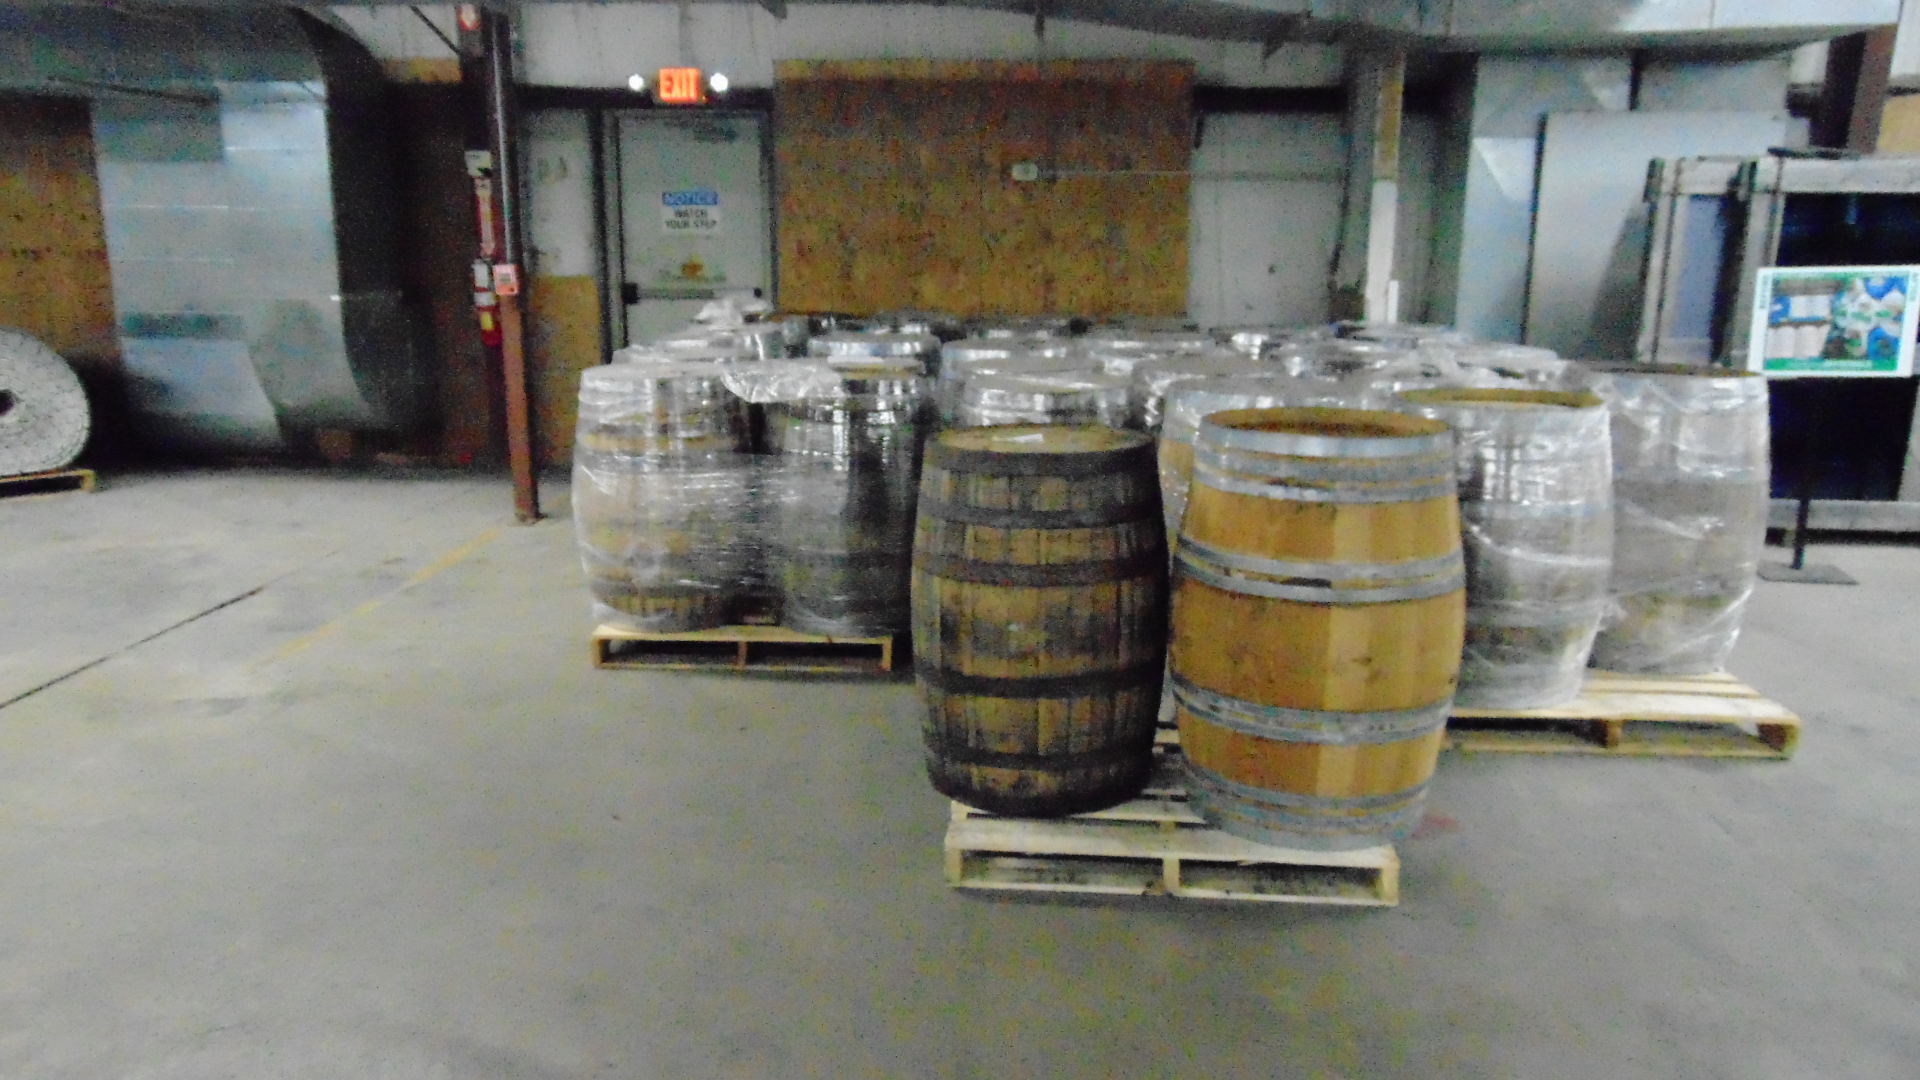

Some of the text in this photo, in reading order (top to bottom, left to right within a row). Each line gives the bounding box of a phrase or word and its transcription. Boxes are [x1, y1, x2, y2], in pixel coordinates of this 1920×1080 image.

[660, 68, 697, 98] EXIT
[664, 192, 716, 204] NOTICE
[674, 209, 708, 218] WATCH
[665, 219, 717, 229] YOUR STEP
